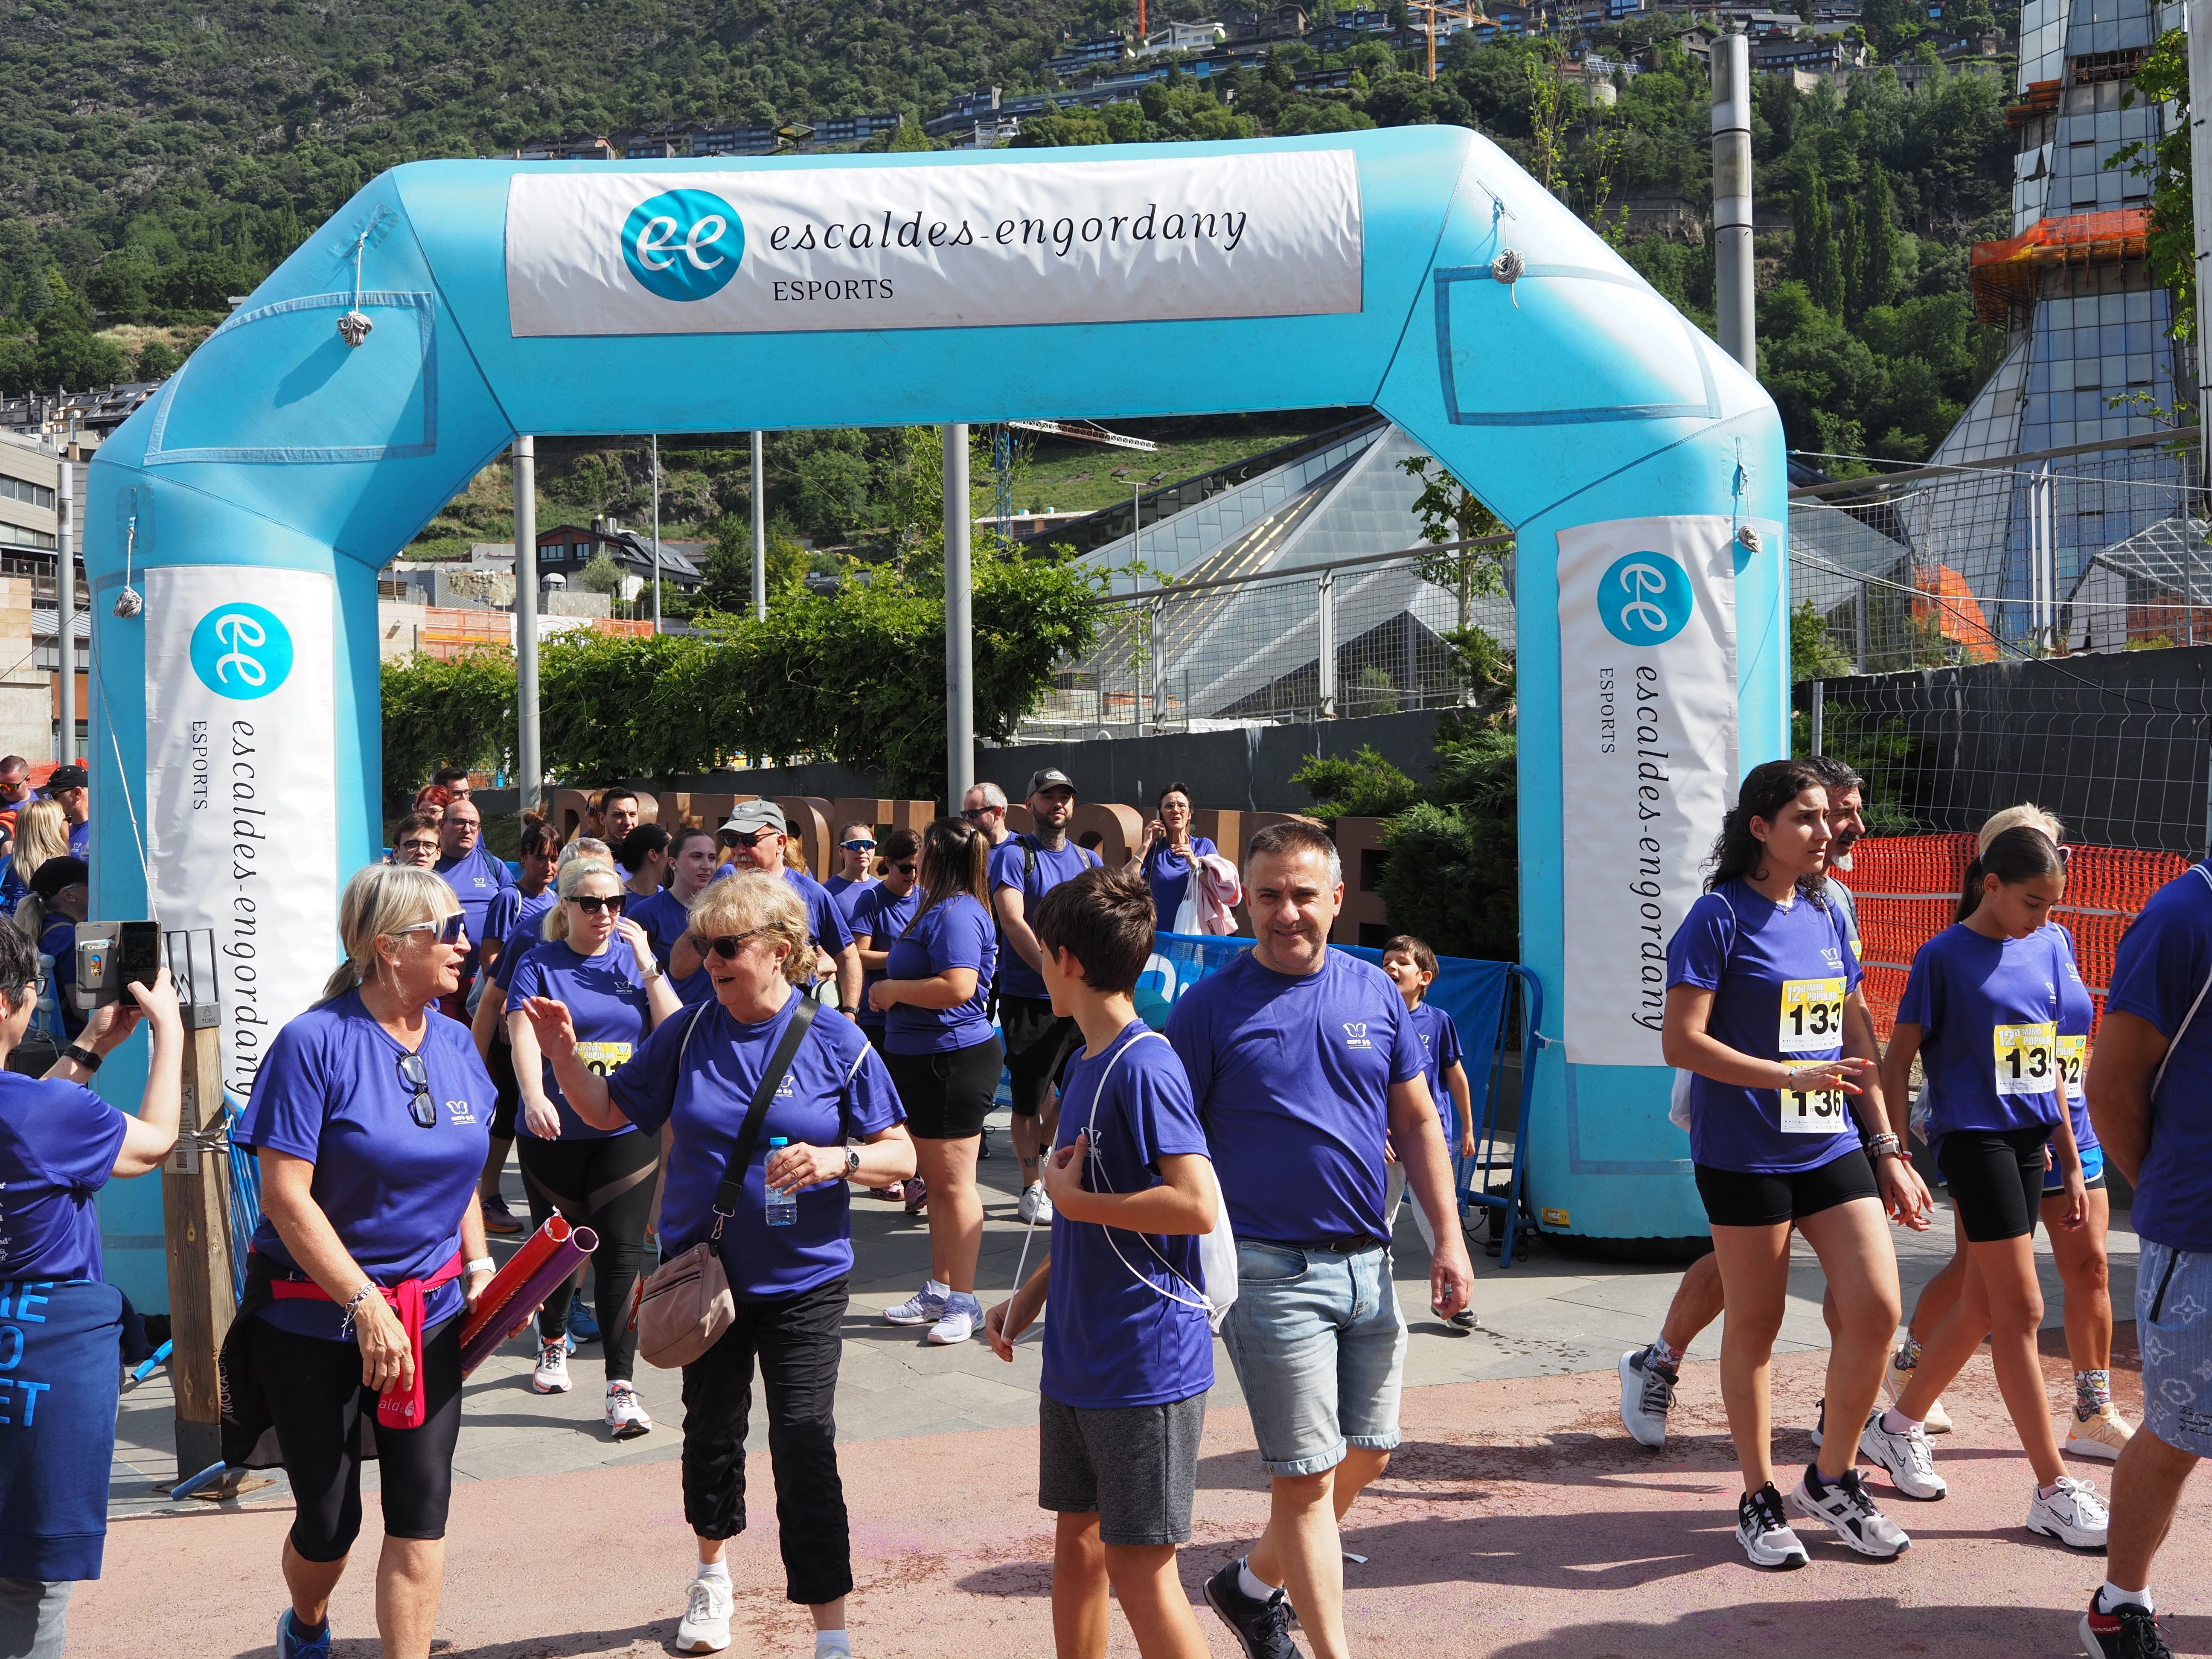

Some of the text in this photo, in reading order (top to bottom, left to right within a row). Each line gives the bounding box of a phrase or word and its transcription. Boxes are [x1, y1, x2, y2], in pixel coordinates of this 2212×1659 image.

[770, 204, 1248, 257] escaldes-engordany
[773, 278, 894, 302] ESPORTS
[1599, 667, 1615, 754] ESPORTS
[192, 720, 208, 810] ESPORTS
[1630, 666, 1669, 1032] escaldes-engordany
[223, 720, 268, 1098] escaldes-engordany
[1807, 983, 1825, 991] MARXA
[1807, 992, 1837, 1002] POPULAR
[1790, 1002, 1841, 1035] 133
[2023, 1027, 2042, 1036] MARXA
[2056, 1047, 2075, 1056] PULAR
[2056, 1057, 2080, 1084] 32
[1792, 1090, 1841, 1117] 136
